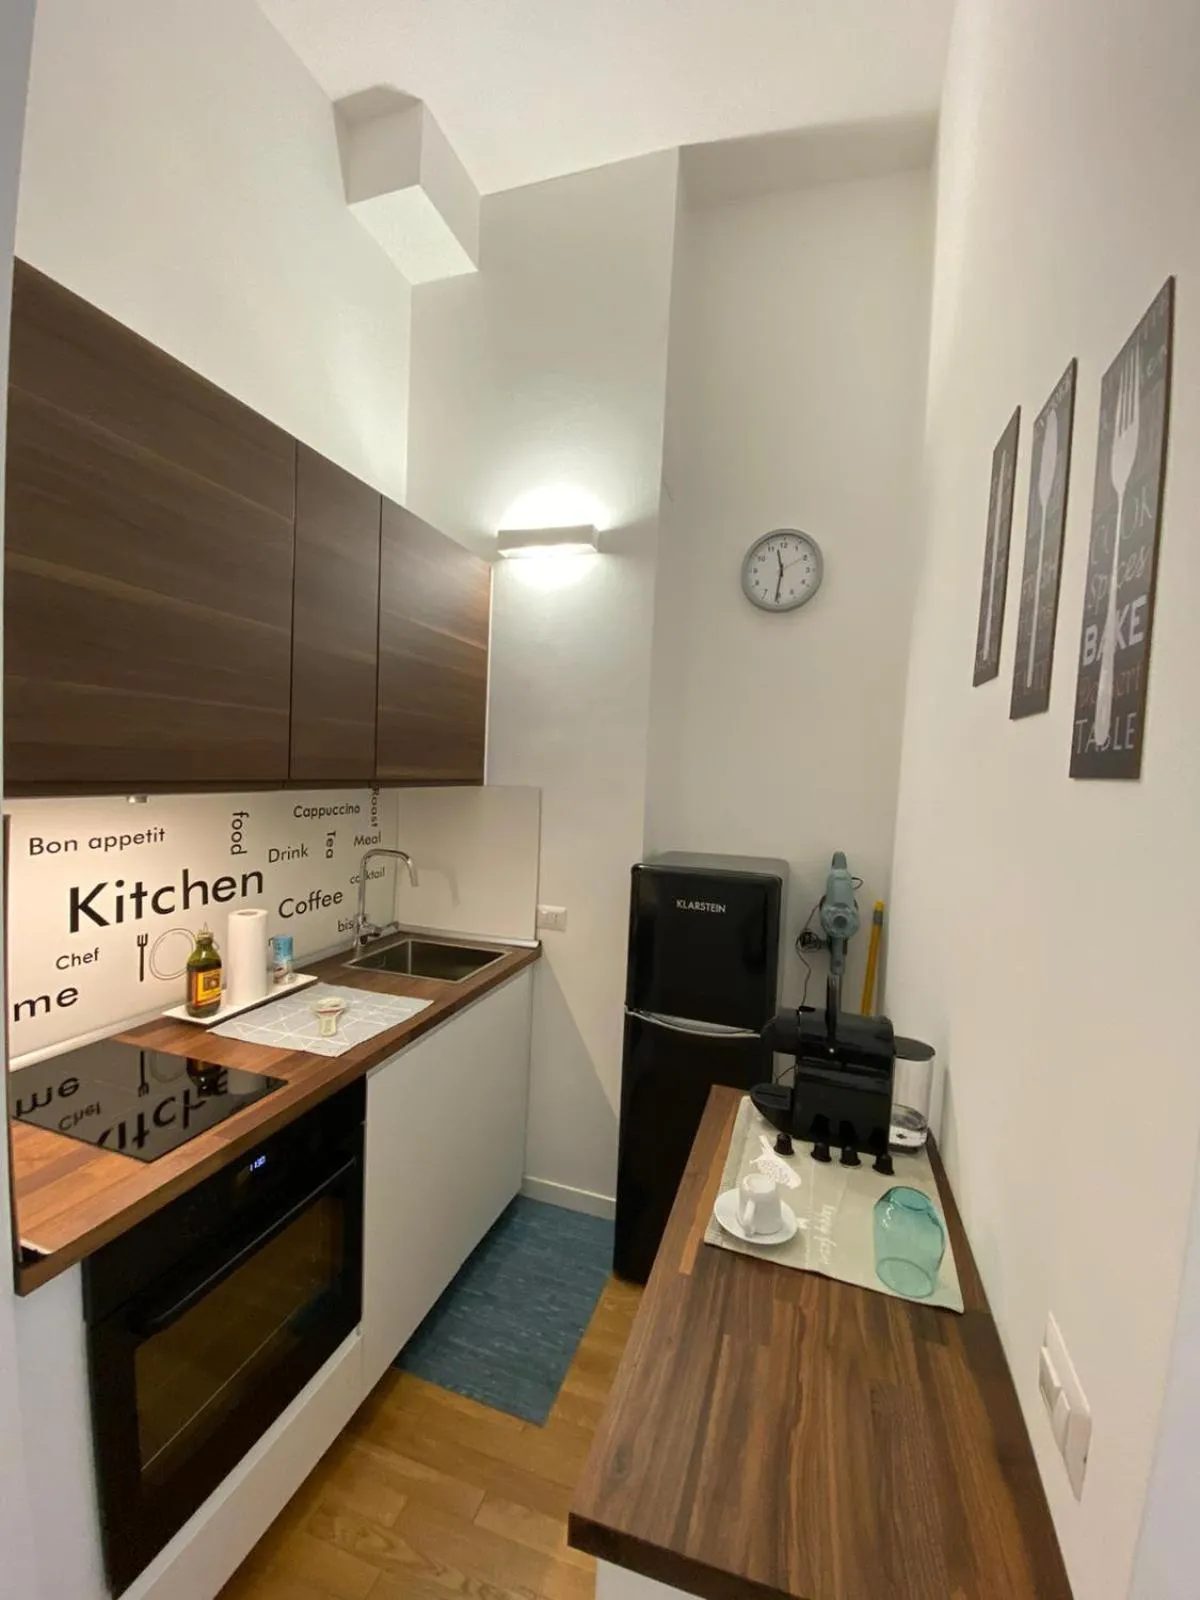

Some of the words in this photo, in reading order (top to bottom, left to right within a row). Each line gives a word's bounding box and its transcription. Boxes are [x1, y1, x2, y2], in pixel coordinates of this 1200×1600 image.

[1075, 711, 1138, 754] TALE
[293, 803, 361, 819] Cappuccino
[29, 836, 78, 856] Bon
[88, 827, 166, 852] appetit
[230, 810, 250, 855] food
[325, 830, 336, 859] Tea
[353, 830, 382, 848] Meal
[268, 843, 309, 863] Drink
[349, 866, 386, 885] coktail
[69, 868, 264, 934] Kitchen
[278, 889, 344, 919] Coffee
[676, 899, 727, 913] KLARSTEIN
[55, 947, 100, 970] Chef
[14, 987, 79, 1022] me
